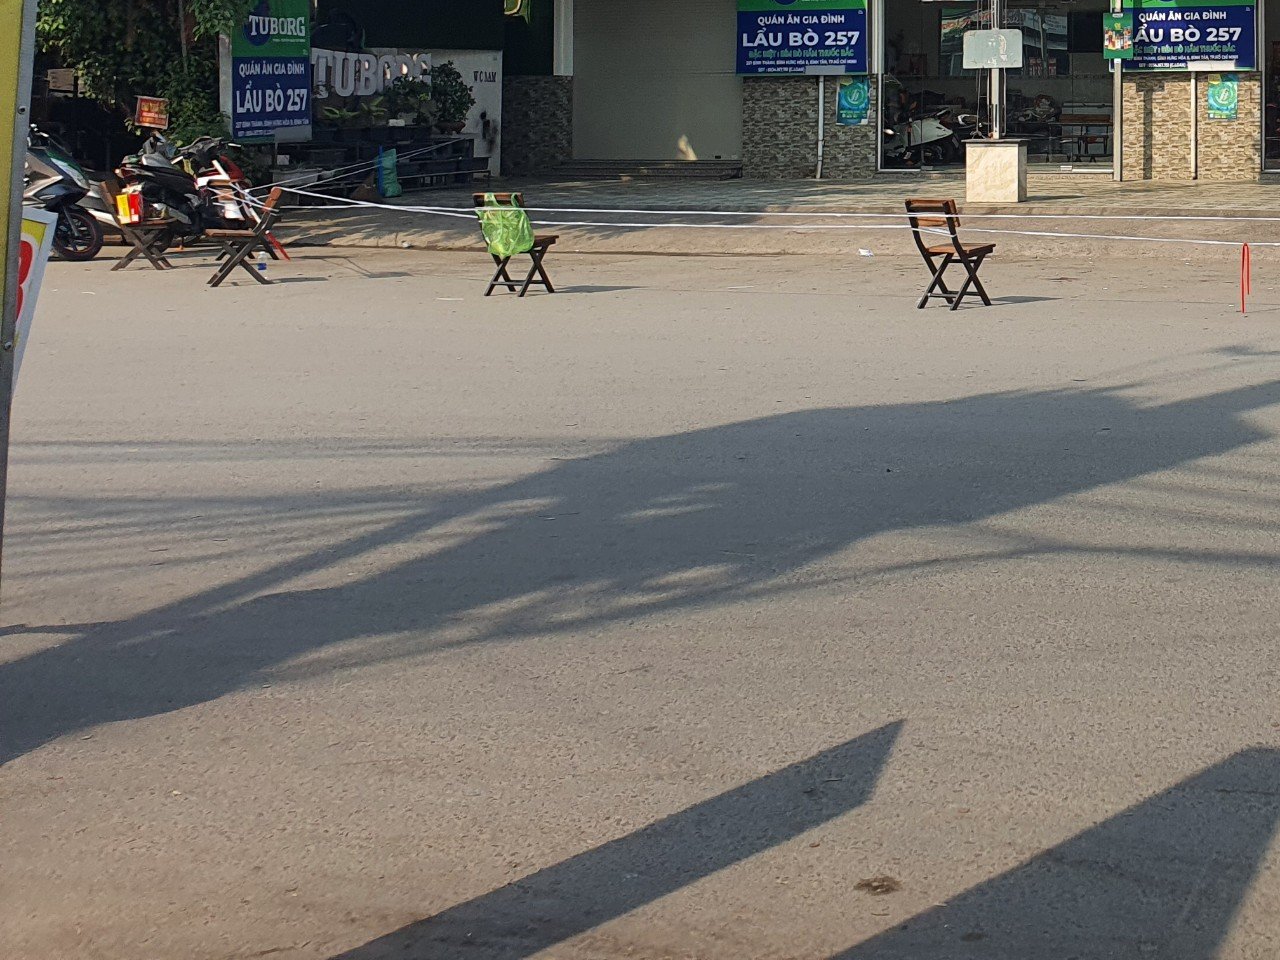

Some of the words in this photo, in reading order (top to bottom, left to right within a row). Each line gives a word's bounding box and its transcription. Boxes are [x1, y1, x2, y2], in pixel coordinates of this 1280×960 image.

[249, 14, 306, 37] TUBORG
[757, 14, 785, 26] QUÁN
[786, 13, 800, 24] ĂN
[802, 15, 819, 24] GIA
[820, 13, 845, 24] ĐÌNH
[1138, 10, 1166, 23] QUÁN
[1167, 10, 1182, 21] ĂN
[1184, 12, 1200, 21] GIA
[1202, 9, 1227, 20] ĐÌNH
[742, 27, 782, 47] LẨU
[788, 28, 819, 47] BÒ
[824, 31, 860, 46] 257
[1133, 23, 1164, 43] ẨU
[1170, 24, 1201, 42] BÒ
[1206, 27, 1242, 42] 257
[238, 60, 260, 77] QUÁN
[262, 60, 273, 75] ĂN
[273, 62, 286, 75] GIA
[287, 60, 305, 75] ĐÌNH
[236, 80, 262, 113] LẨU
[265, 82, 284, 112] BÒ
[286, 88, 308, 112] 257
